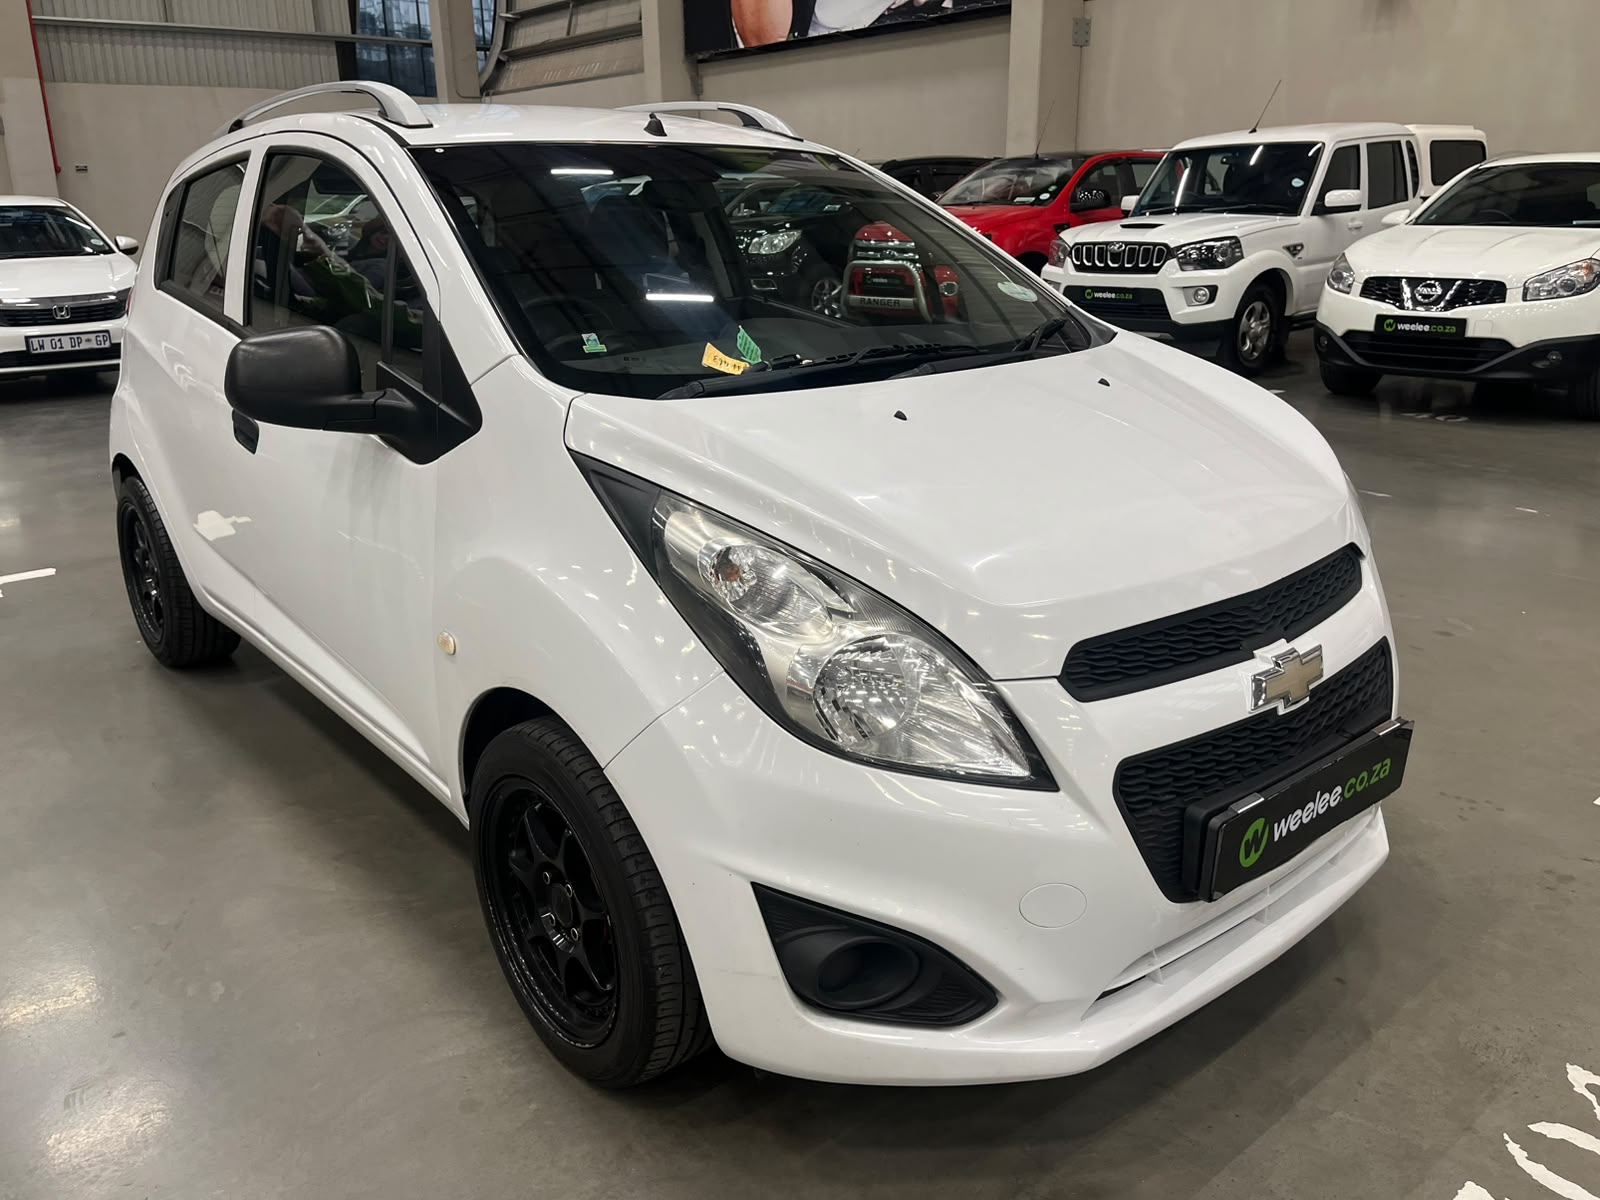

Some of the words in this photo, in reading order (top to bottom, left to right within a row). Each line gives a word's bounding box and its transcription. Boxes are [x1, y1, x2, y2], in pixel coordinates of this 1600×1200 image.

[860, 298, 900, 307] RANGER
[1397, 322, 1456, 333] weelee.co.za
[50, 338, 64, 350] 01
[69, 336, 82, 348] DP
[95, 334, 109, 346] GP
[1273, 758, 1391, 842] weelee.co.za
